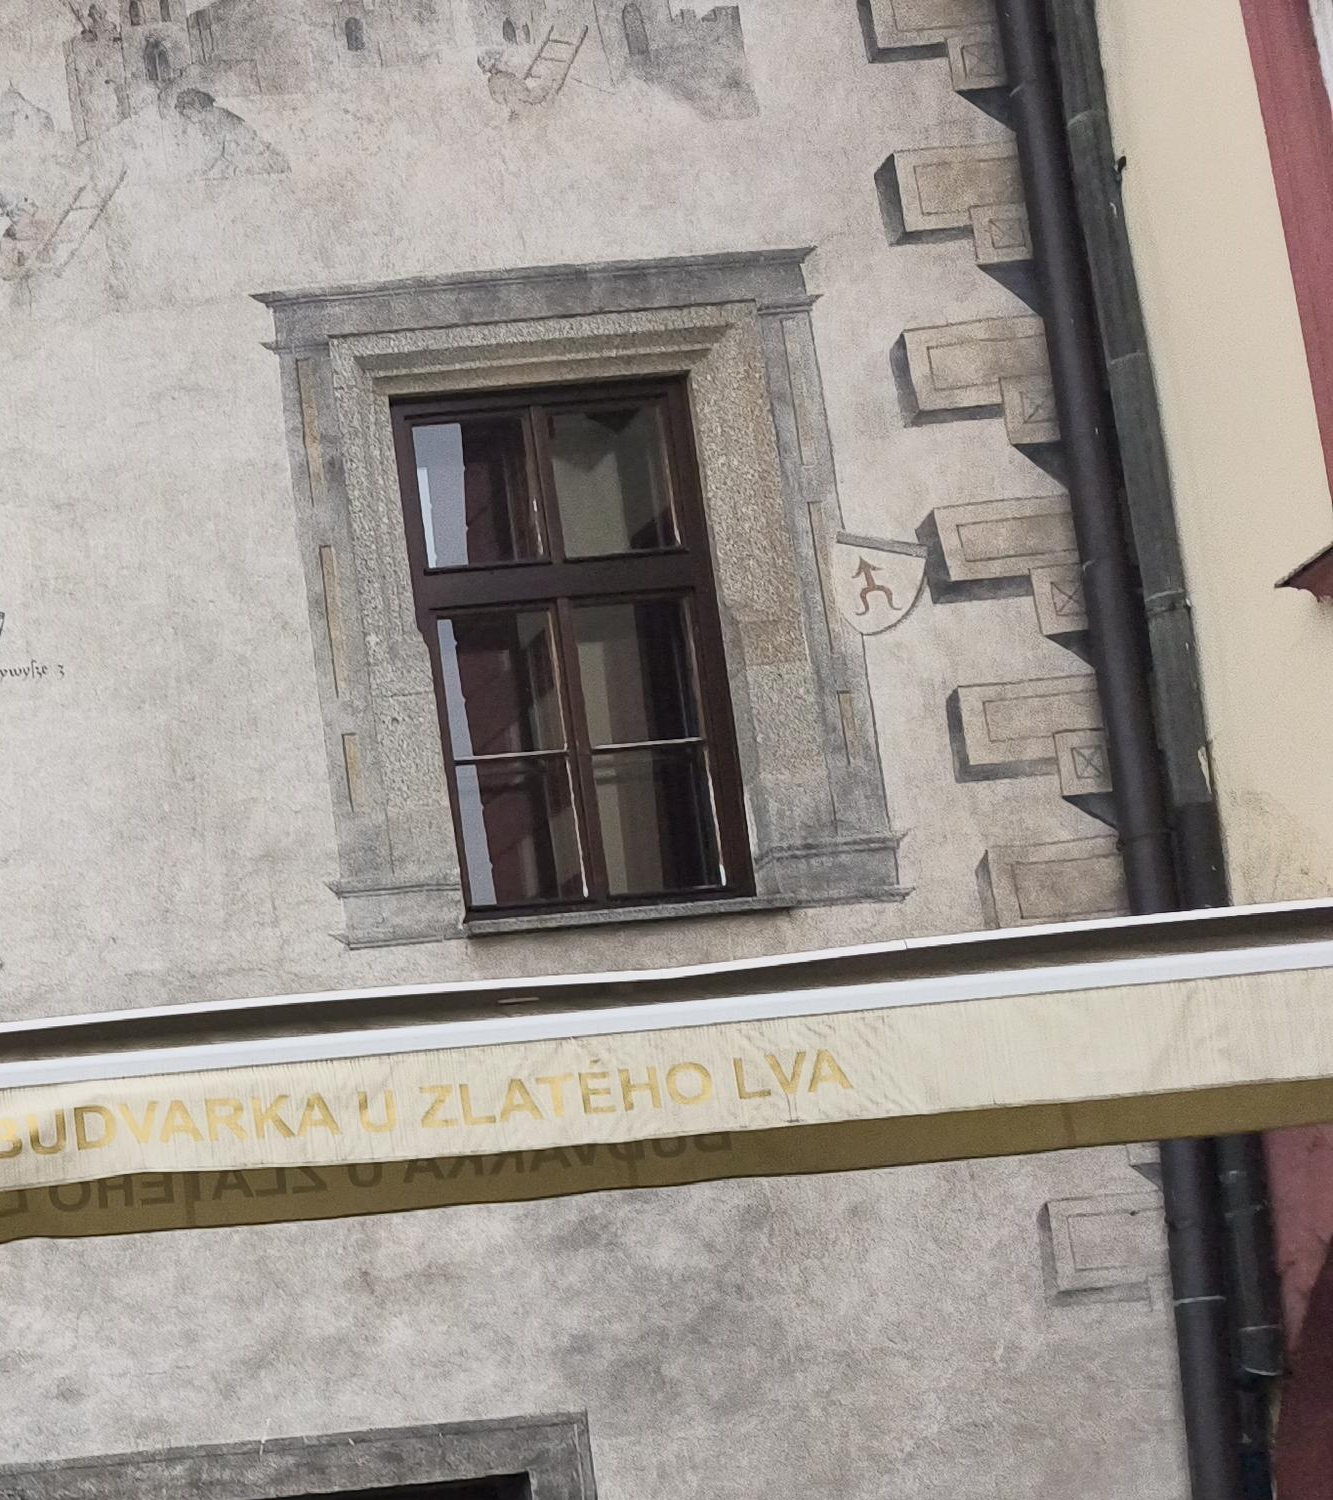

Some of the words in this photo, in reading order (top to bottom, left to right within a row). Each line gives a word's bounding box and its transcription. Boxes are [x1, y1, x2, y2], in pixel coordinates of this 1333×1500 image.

[357, 1090, 399, 1132] U
[418, 1058, 715, 1129] ZLATÉHO
[732, 1047, 854, 1101] LVA
